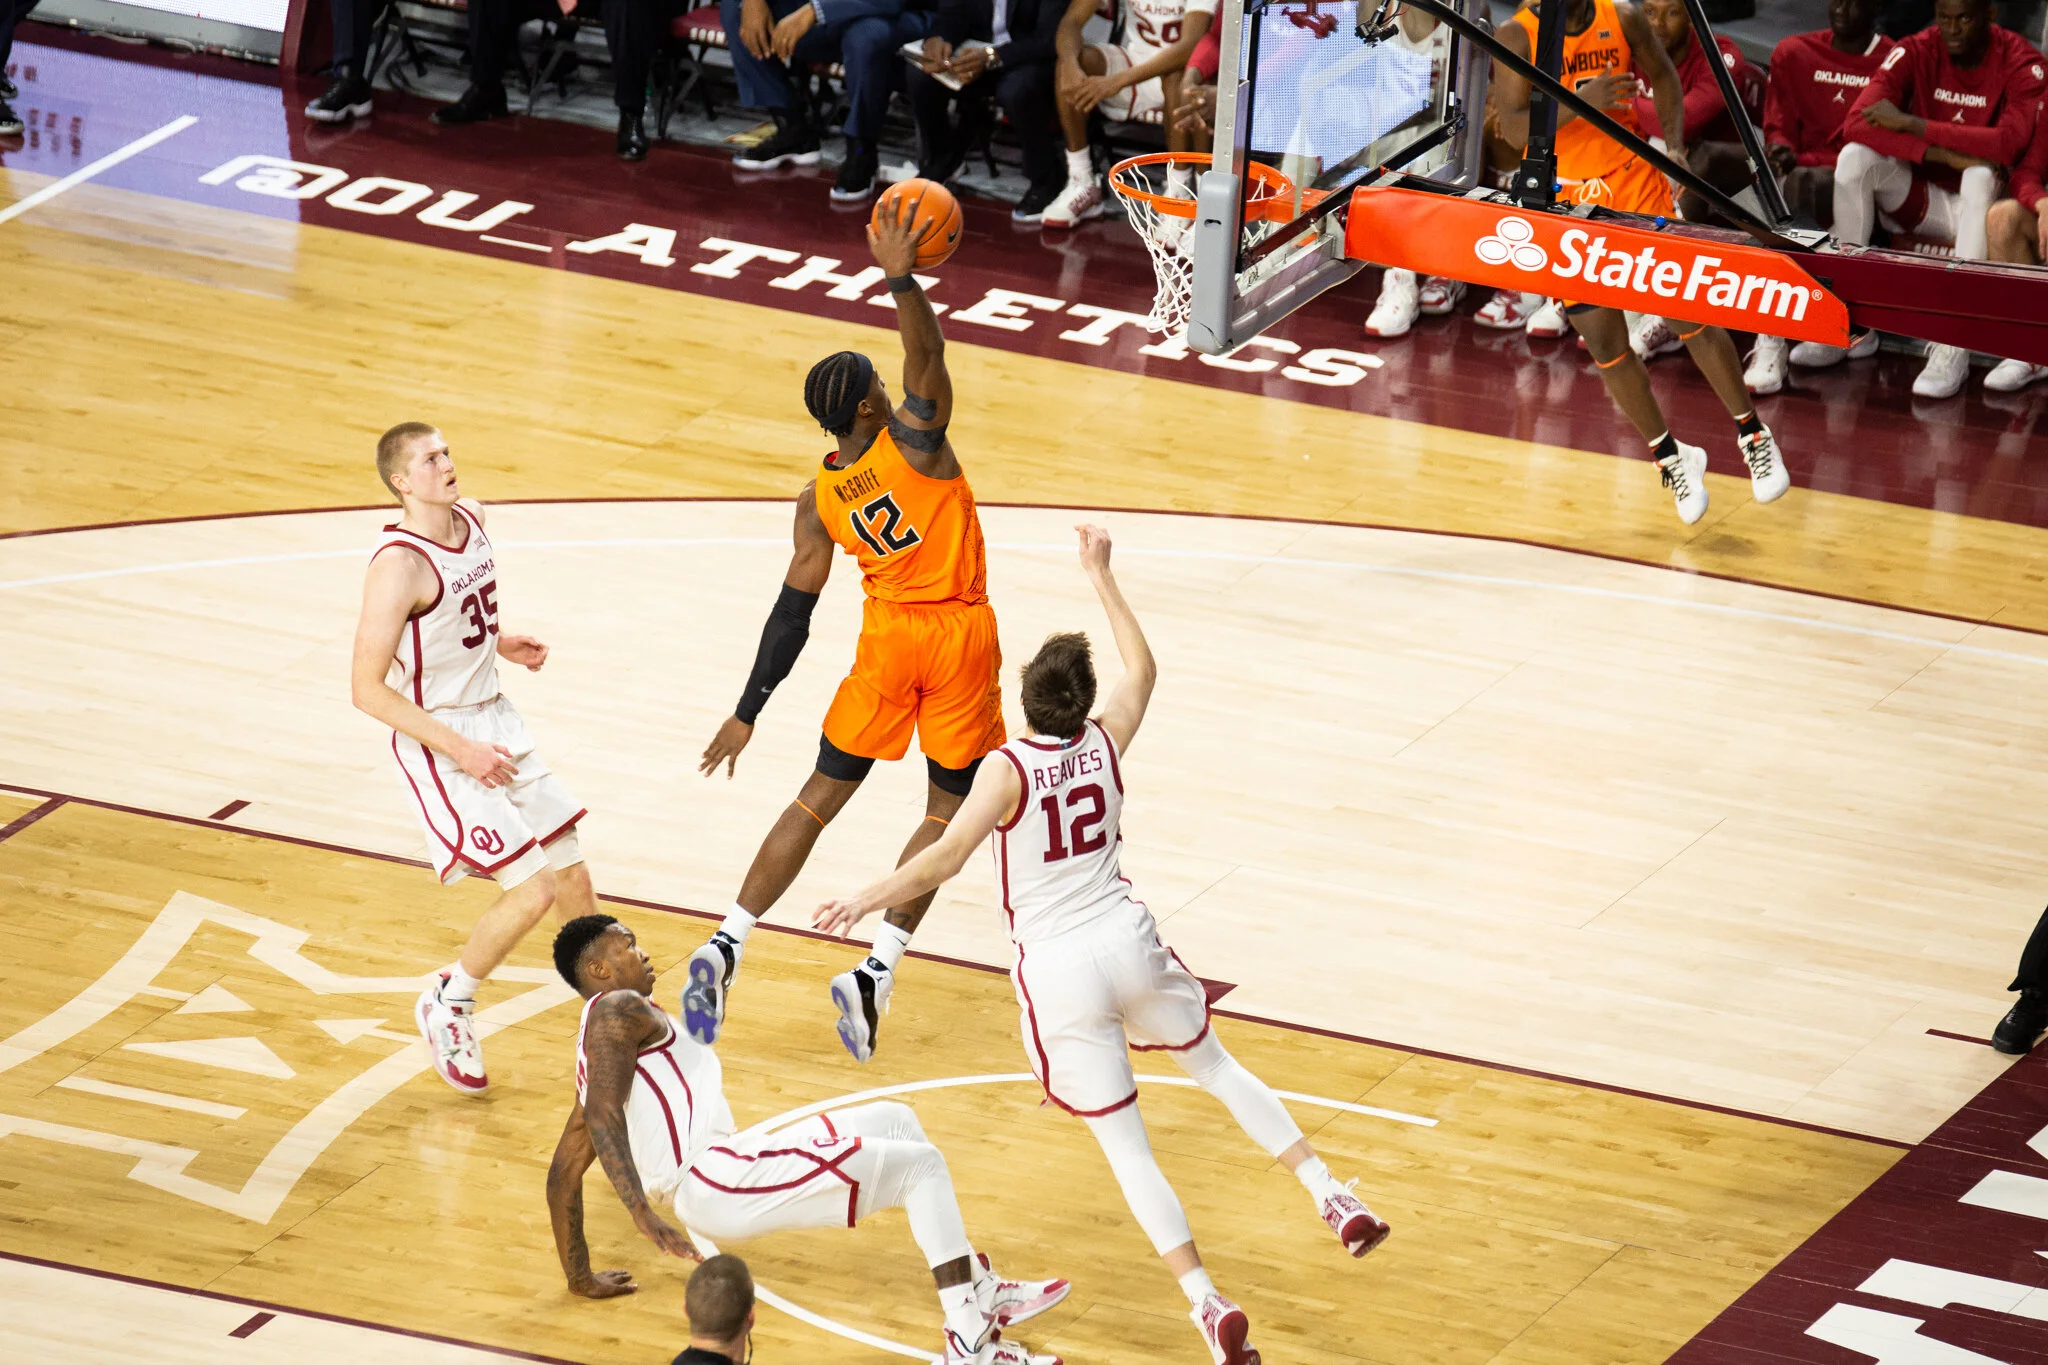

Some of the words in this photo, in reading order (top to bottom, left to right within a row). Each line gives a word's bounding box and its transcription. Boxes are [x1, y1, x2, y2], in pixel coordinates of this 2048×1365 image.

[1814, 69, 1870, 88] OKLAHOMA
[833, 467, 881, 504] McGRIFF
[849, 490, 922, 557] 12
[451, 558, 496, 594] OKLAHOMA
[460, 580, 499, 650] 35
[1033, 749, 1103, 791] REAVES
[1040, 782, 1107, 863] 12
